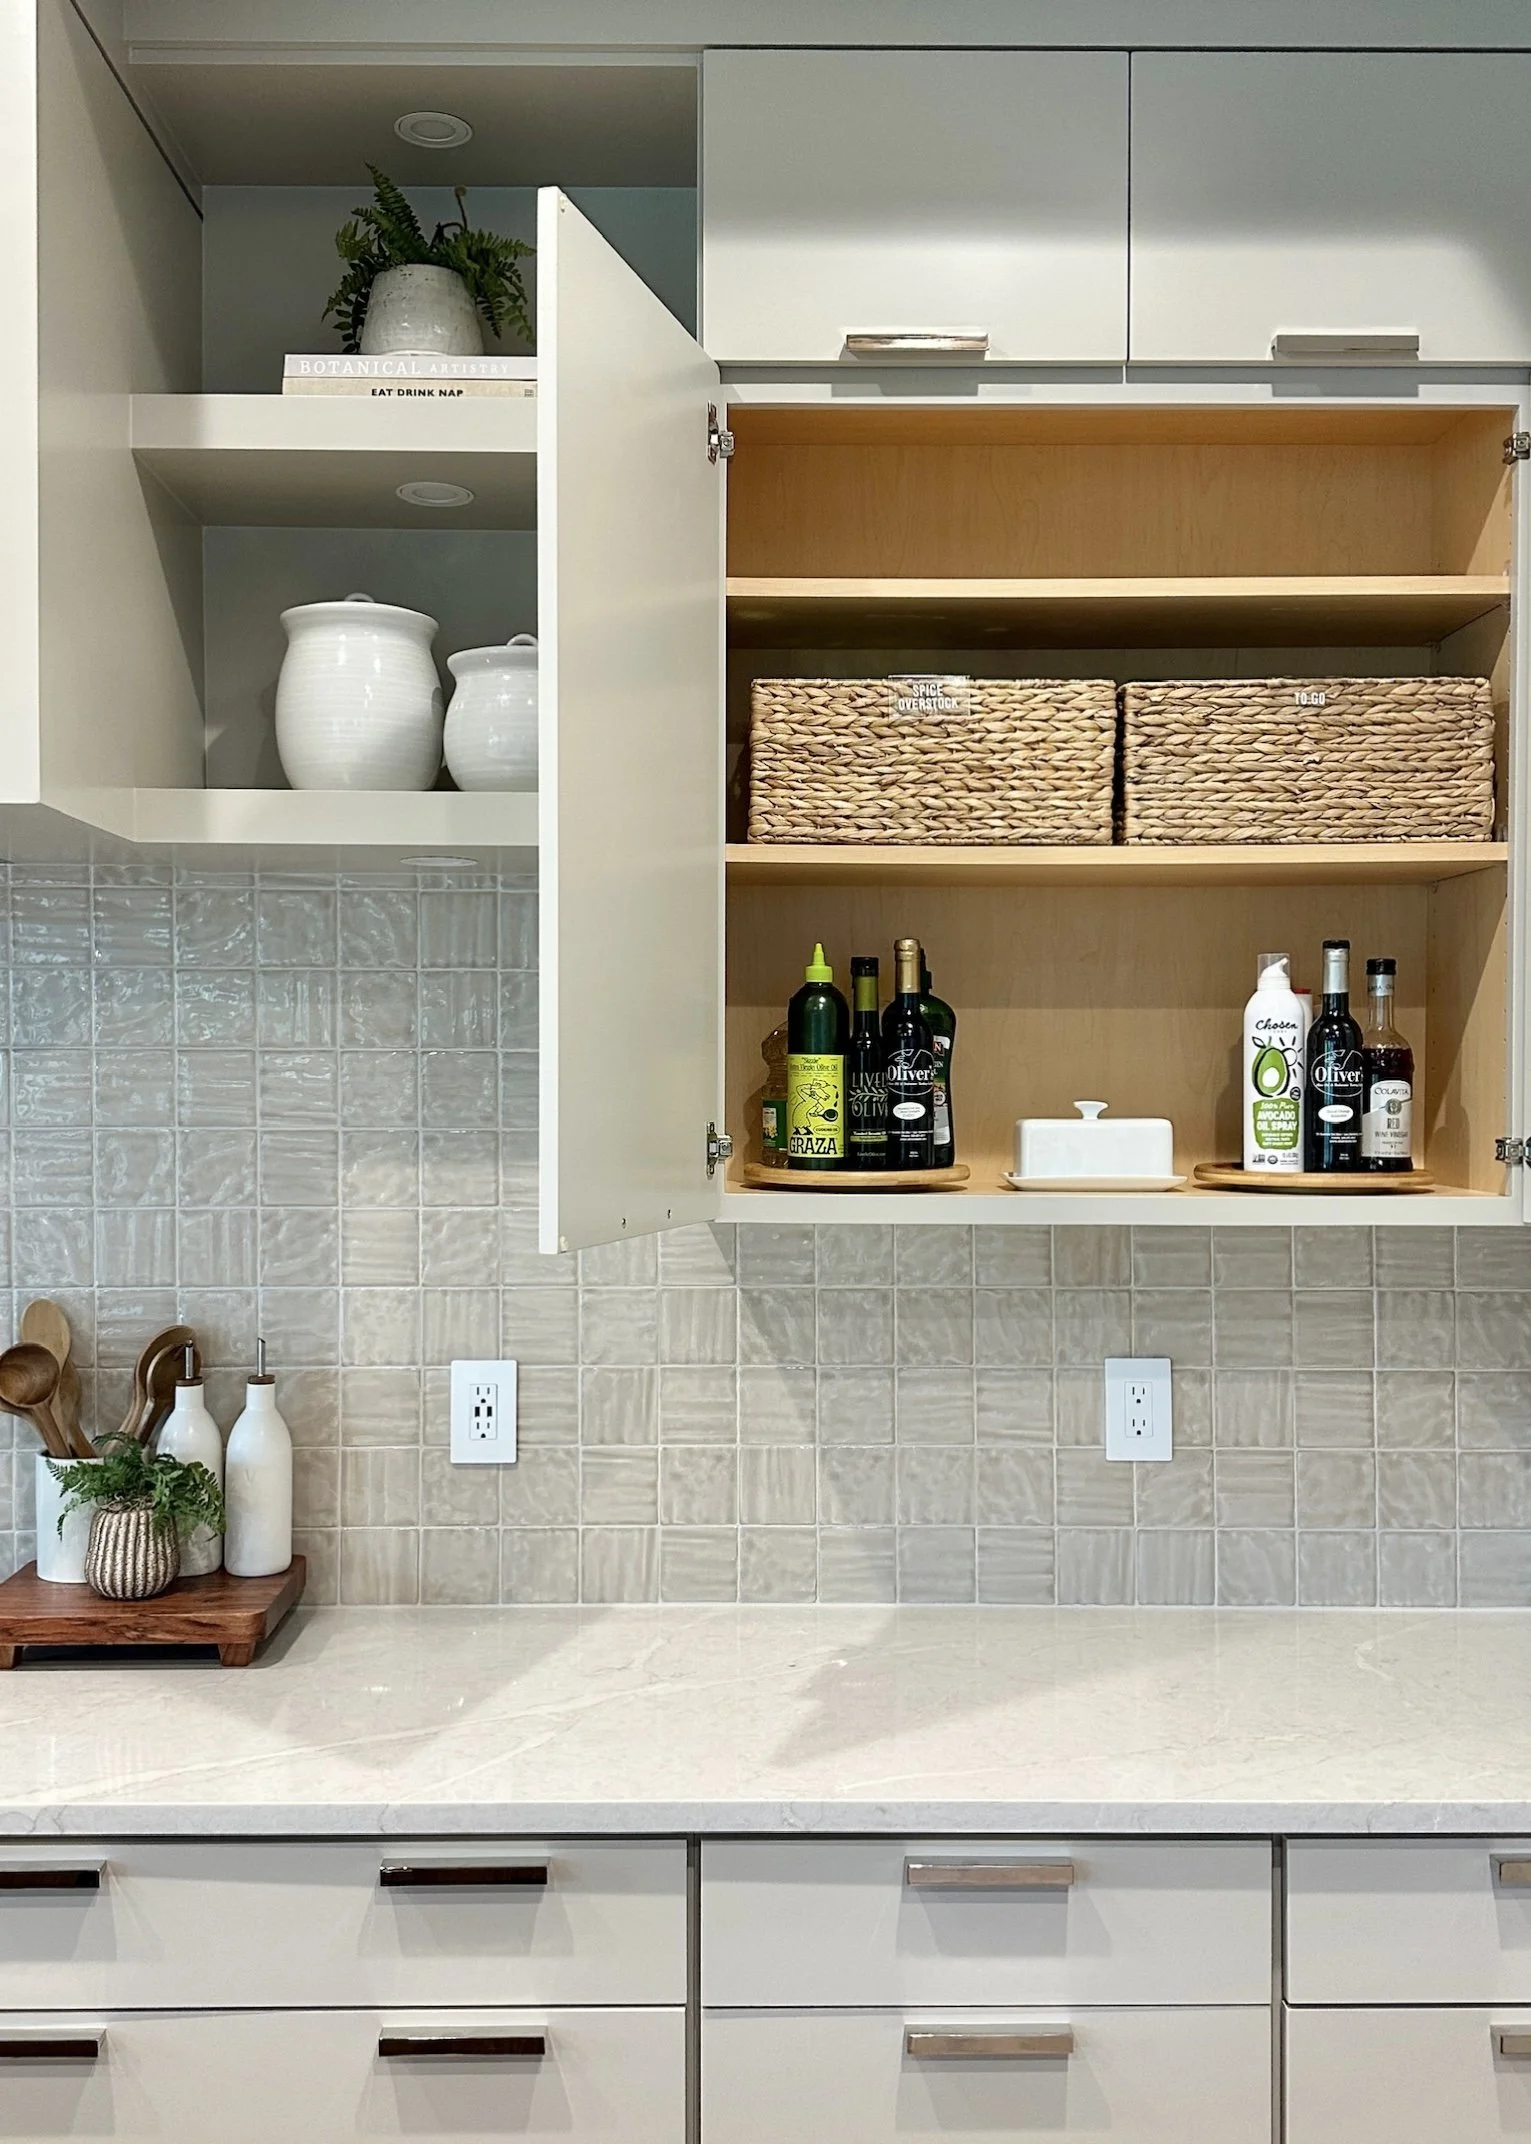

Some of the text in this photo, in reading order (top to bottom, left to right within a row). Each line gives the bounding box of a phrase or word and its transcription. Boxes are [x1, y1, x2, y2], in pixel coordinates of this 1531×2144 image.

[299, 360, 509, 375] BOTANICAL ARTISTRY
[371, 388, 464, 397] EAT DRINK NAP
[912, 683, 943, 697] SPICE
[898, 696, 959, 711] OVERSTOCK
[1255, 1017, 1298, 1031] Chosen
[852, 1071, 888, 1088] LIVEL
[1256, 1110, 1296, 1121] AVOCADO
[1256, 1120, 1298, 1131] OIL SPRAY
[789, 1136, 838, 1155] GRAZA
